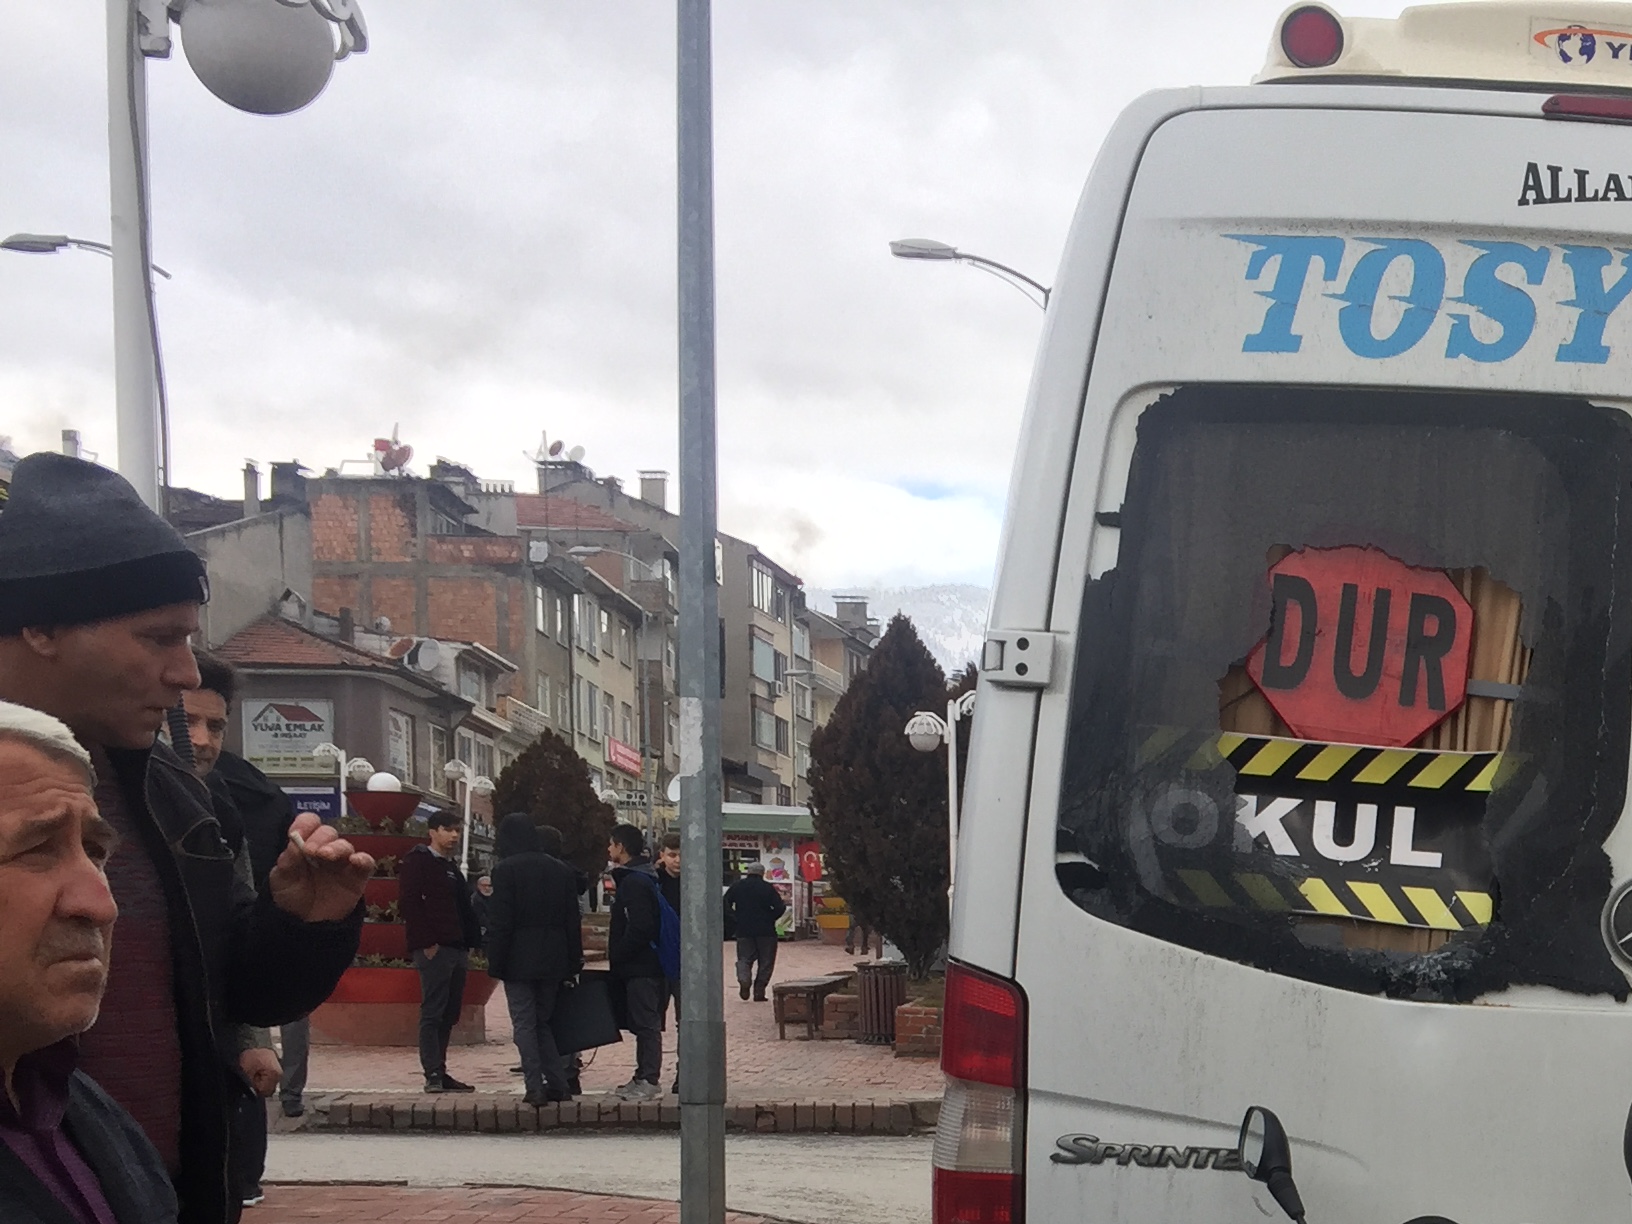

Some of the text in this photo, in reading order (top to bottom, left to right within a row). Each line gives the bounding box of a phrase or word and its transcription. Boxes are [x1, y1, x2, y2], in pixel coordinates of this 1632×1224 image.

[1261, 573, 1457, 712] DUR
[251, 722, 325, 732] YUVA EMLAK
[296, 800, 331, 812] İLETİŞİM
[1150, 781, 1443, 869] OKUL
[1050, 1133, 1243, 1172] SPRINTE
